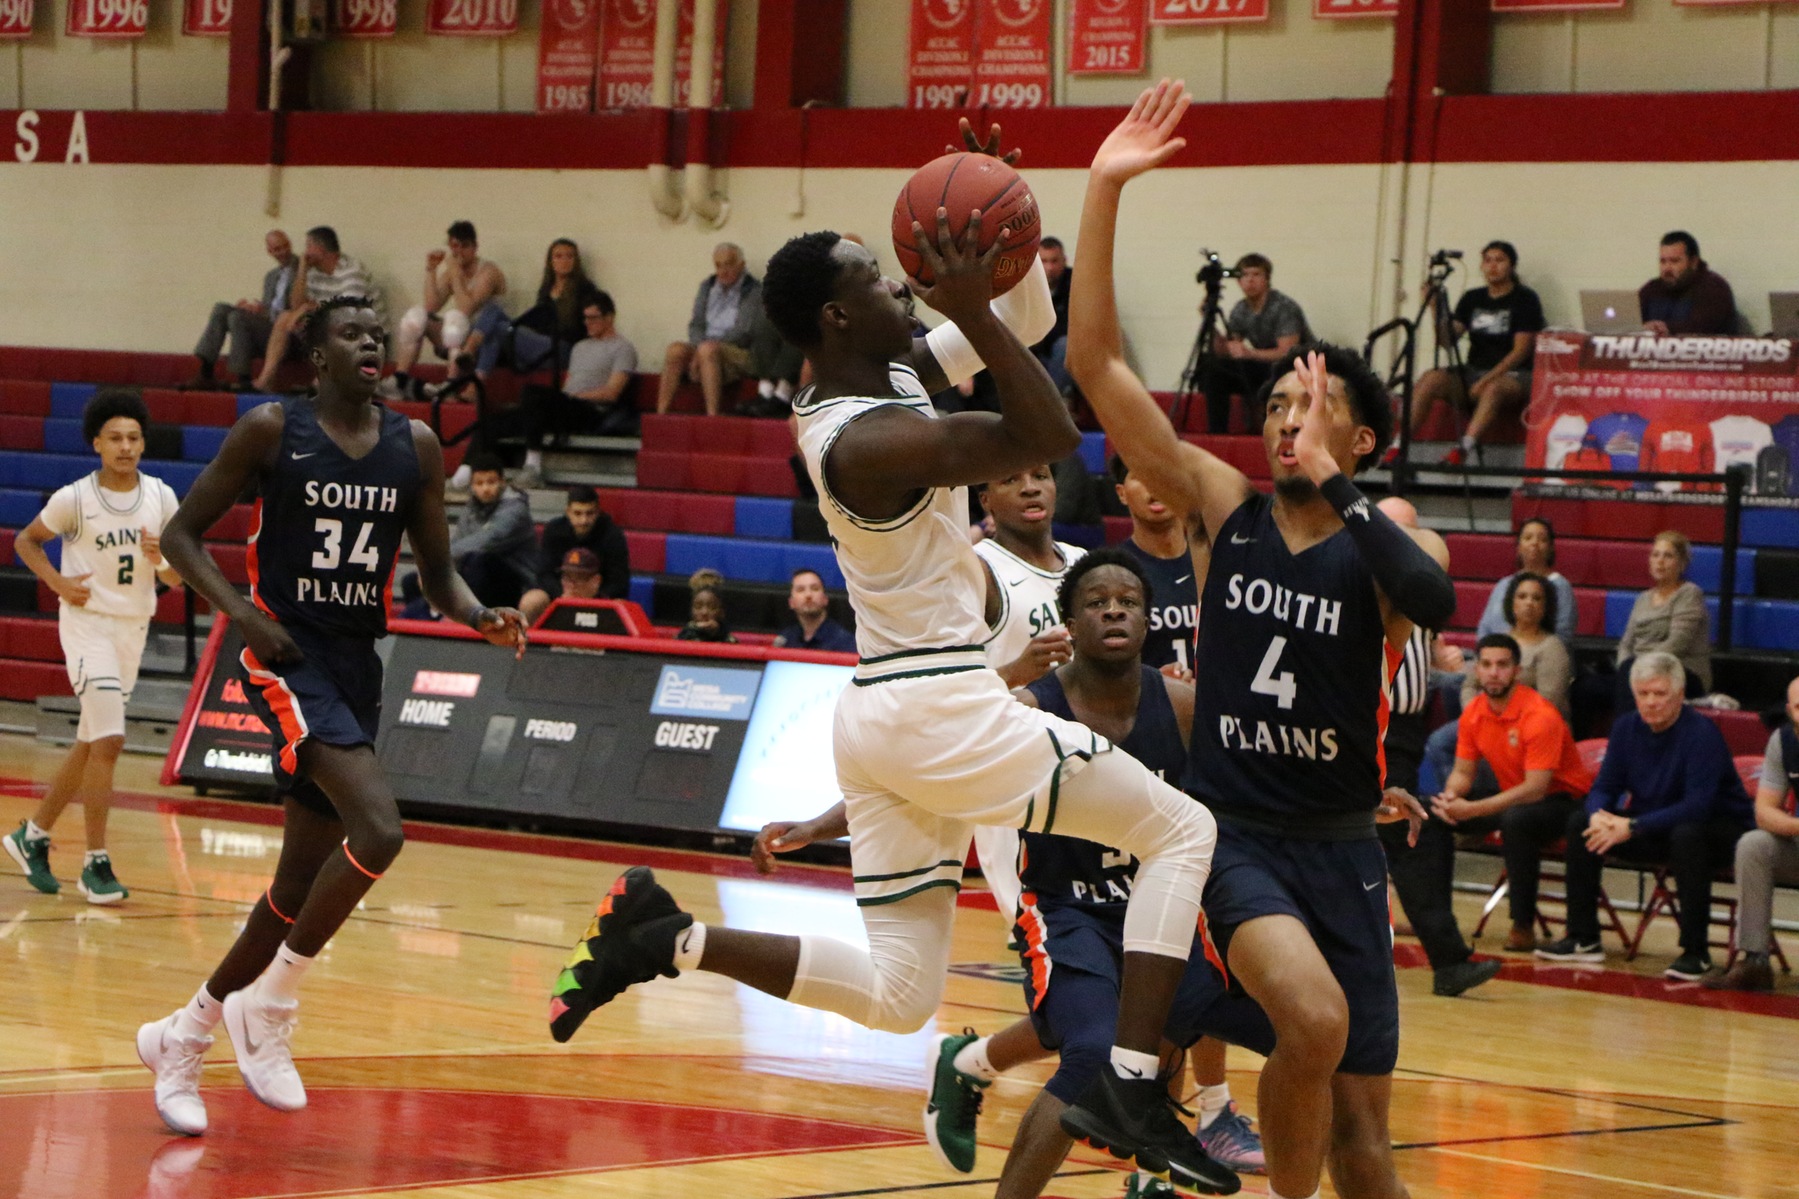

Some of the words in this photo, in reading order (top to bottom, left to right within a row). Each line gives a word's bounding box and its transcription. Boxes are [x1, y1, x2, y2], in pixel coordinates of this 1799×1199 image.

[83, 0, 147, 28] 1996
[339, 0, 397, 27] 998
[438, 0, 518, 27] 2010
[1085, 45, 1131, 68] 2015
[544, 84, 589, 110] 1985
[978, 83, 1042, 109] 1999
[1591, 336, 1791, 362] THUNDERBIRDS
[304, 480, 398, 513] SOUTH
[311, 518, 379, 573] 34
[117, 554, 134, 585] 2
[297, 576, 379, 607] PLAINS
[1225, 573, 1342, 637] SOUTH
[1149, 604, 1197, 631] SOU
[1250, 635, 1297, 709] 4
[400, 698, 455, 727] HOME
[524, 718, 577, 742] PERIOD
[654, 721, 720, 750] GUEST
[1219, 714, 1339, 762] PLAINS
